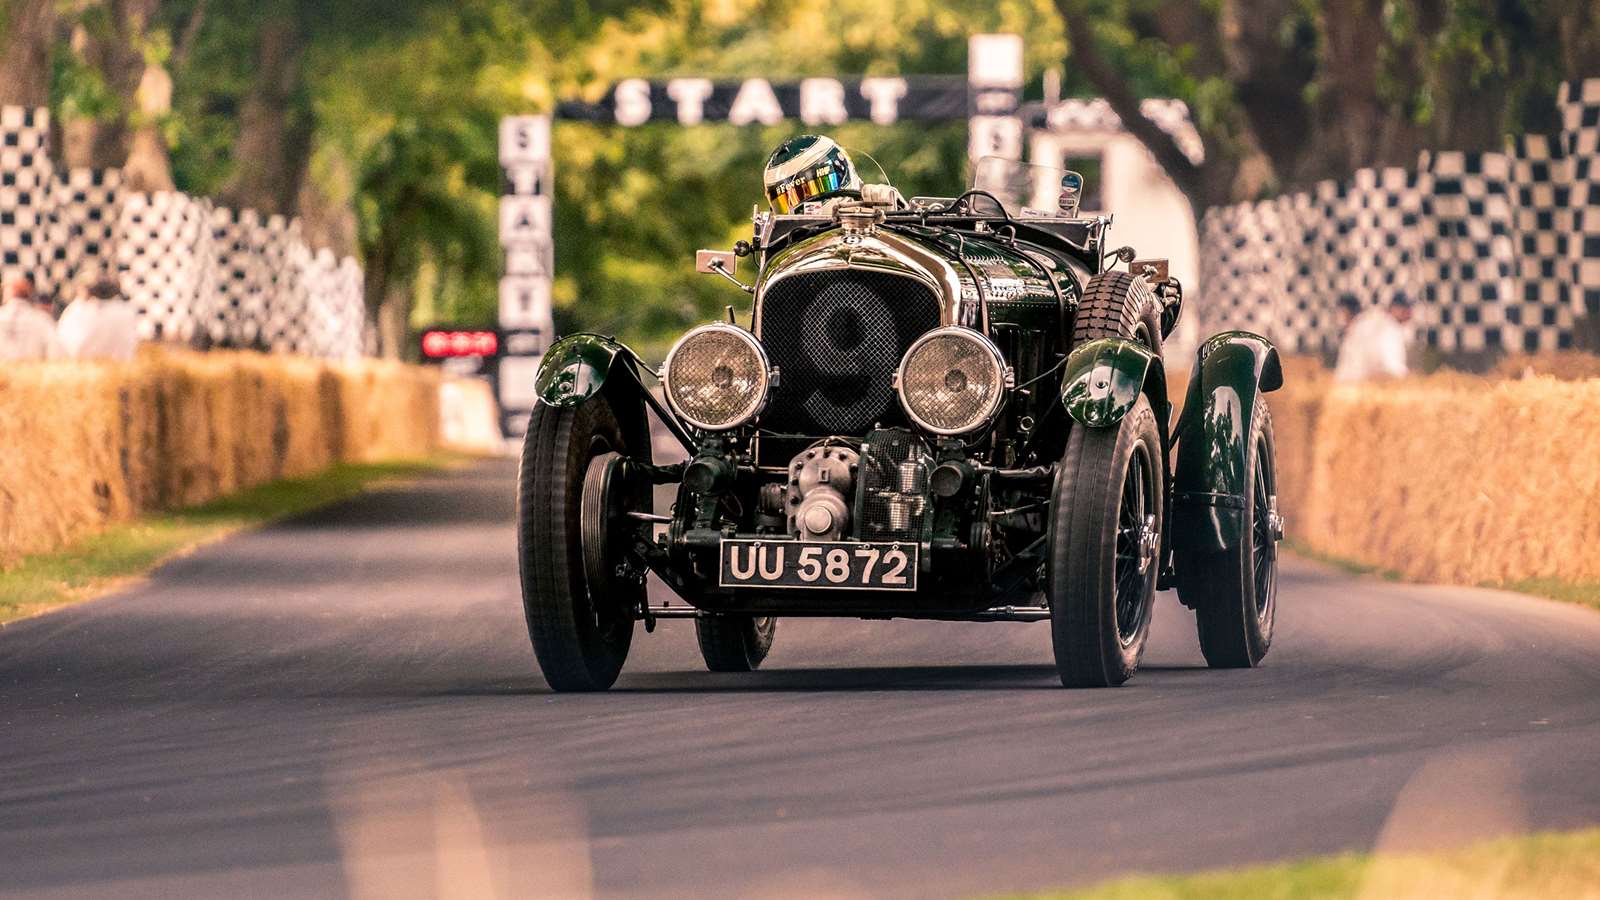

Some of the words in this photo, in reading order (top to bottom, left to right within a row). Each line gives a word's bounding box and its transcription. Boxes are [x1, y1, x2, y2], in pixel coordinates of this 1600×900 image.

[613, 77, 909, 126] START
[800, 280, 899, 432] 9
[730, 544, 785, 581] UU
[797, 546, 909, 585] 5872
